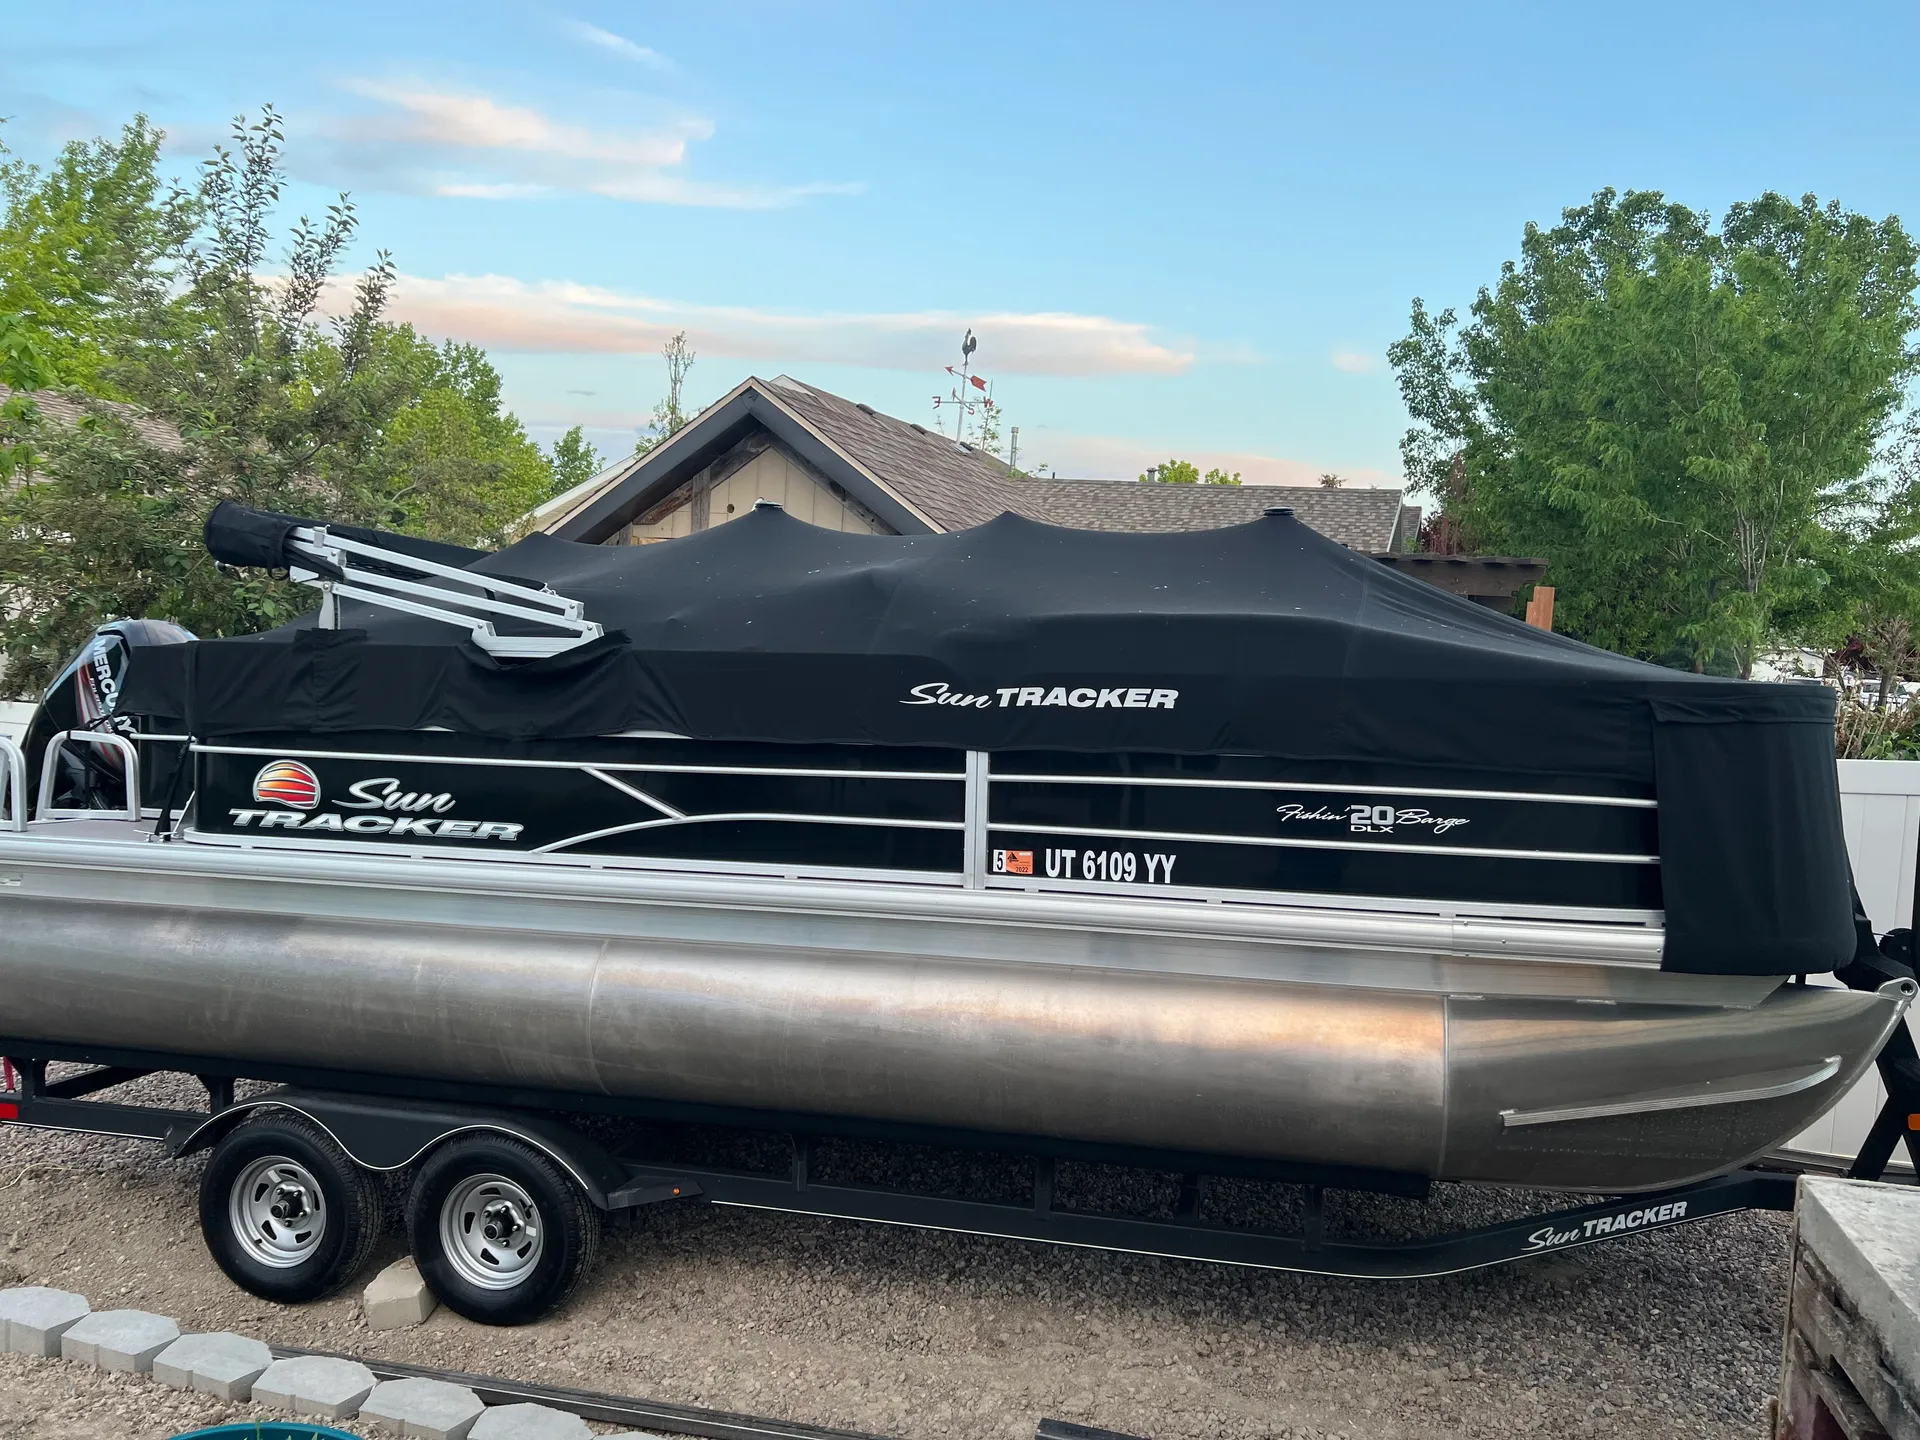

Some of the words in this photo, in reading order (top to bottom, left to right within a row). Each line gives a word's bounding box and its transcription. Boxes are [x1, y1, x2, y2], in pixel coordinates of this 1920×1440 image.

[899, 682, 992, 709] Sun
[996, 687, 1179, 709] TRACKER
[332, 777, 456, 813] Sun
[228, 808, 525, 841] TRACKER
[1276, 804, 1350, 822] Fishin'
[1350, 804, 1395, 825] 20
[1395, 808, 1470, 834] Barge
[1350, 825, 1394, 833] DLX
[996, 851, 1004, 871] 5
[1045, 848, 1076, 878] UT
[1082, 850, 1137, 882] 6109
[1143, 853, 1177, 883] YY
[1520, 1227, 1581, 1251] Sun
[1583, 1201, 1688, 1237] TRACKER
